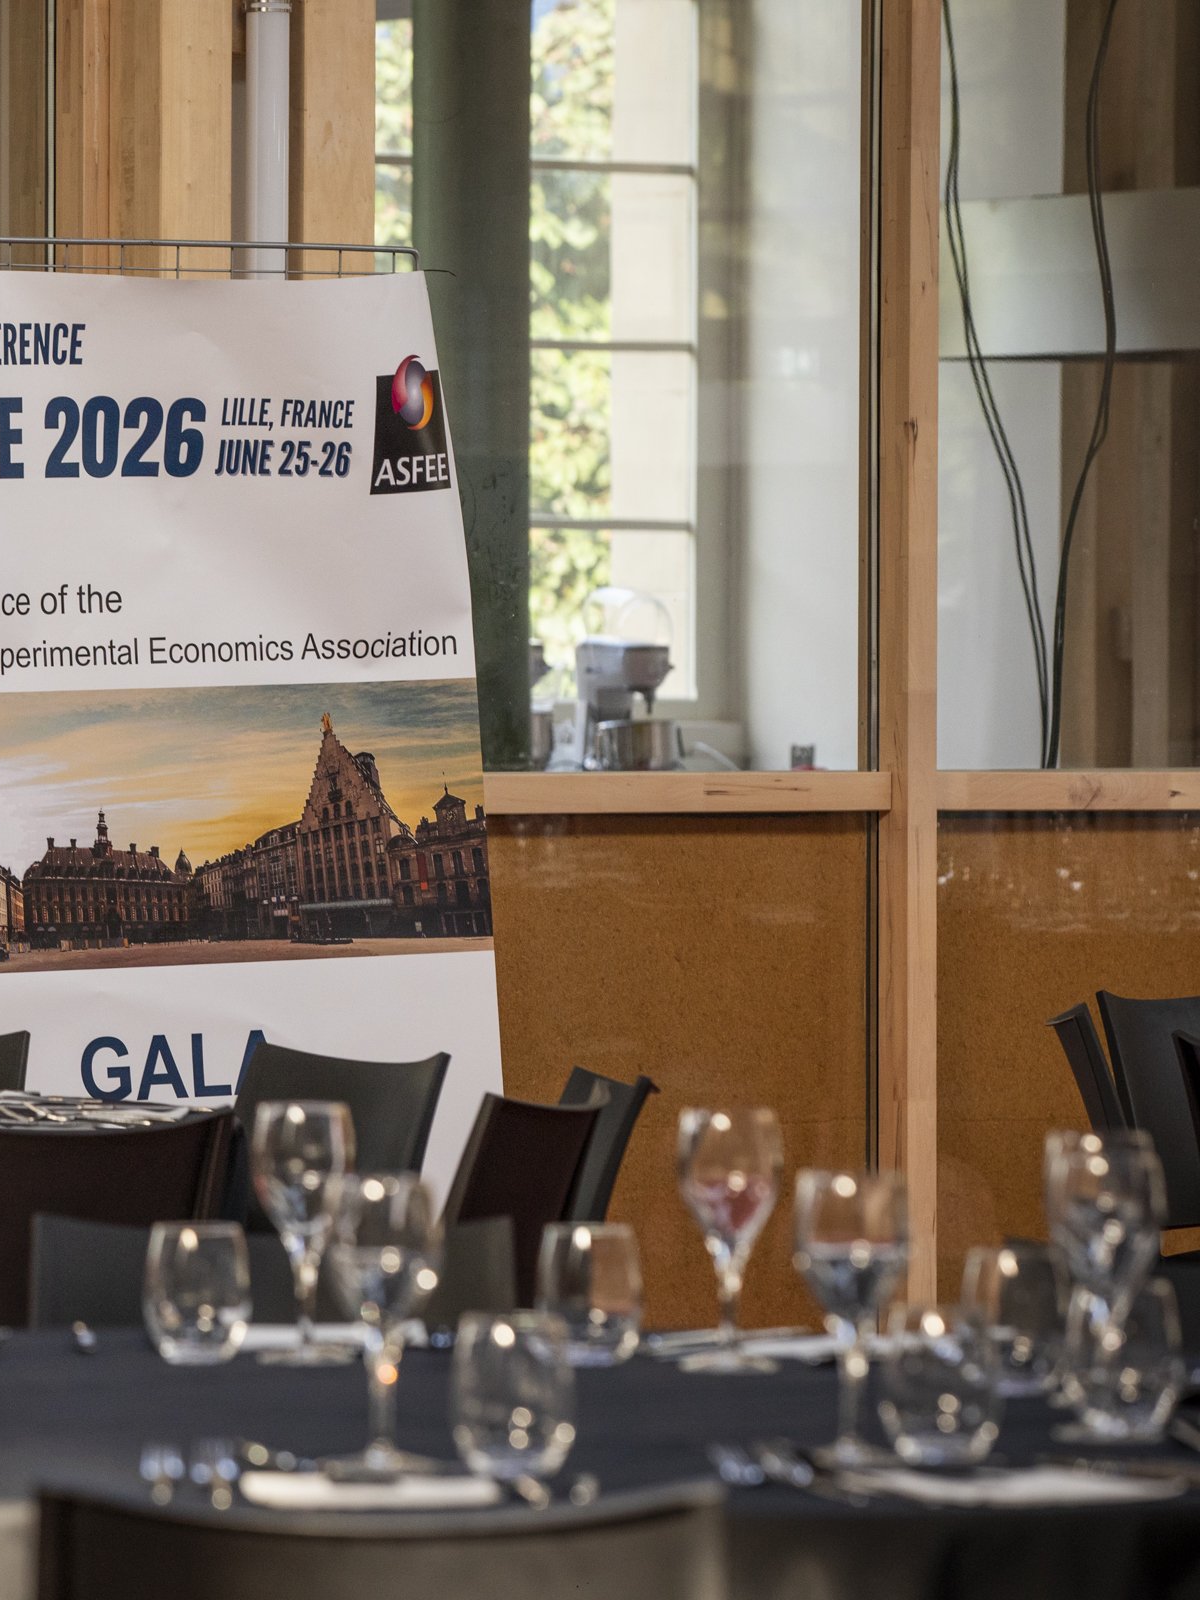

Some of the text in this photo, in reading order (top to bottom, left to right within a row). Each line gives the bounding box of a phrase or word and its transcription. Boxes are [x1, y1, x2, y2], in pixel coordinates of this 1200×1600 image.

[221, 397, 355, 432] LILLE, FRANCE
[45, 396, 207, 478] 2026
[214, 439, 353, 478] JUNE 25-26
[375, 453, 449, 487] ASFEE
[41, 583, 70, 615] of
[77, 584, 123, 614] the
[150, 634, 294, 665] Economics
[301, 630, 458, 660] Association
